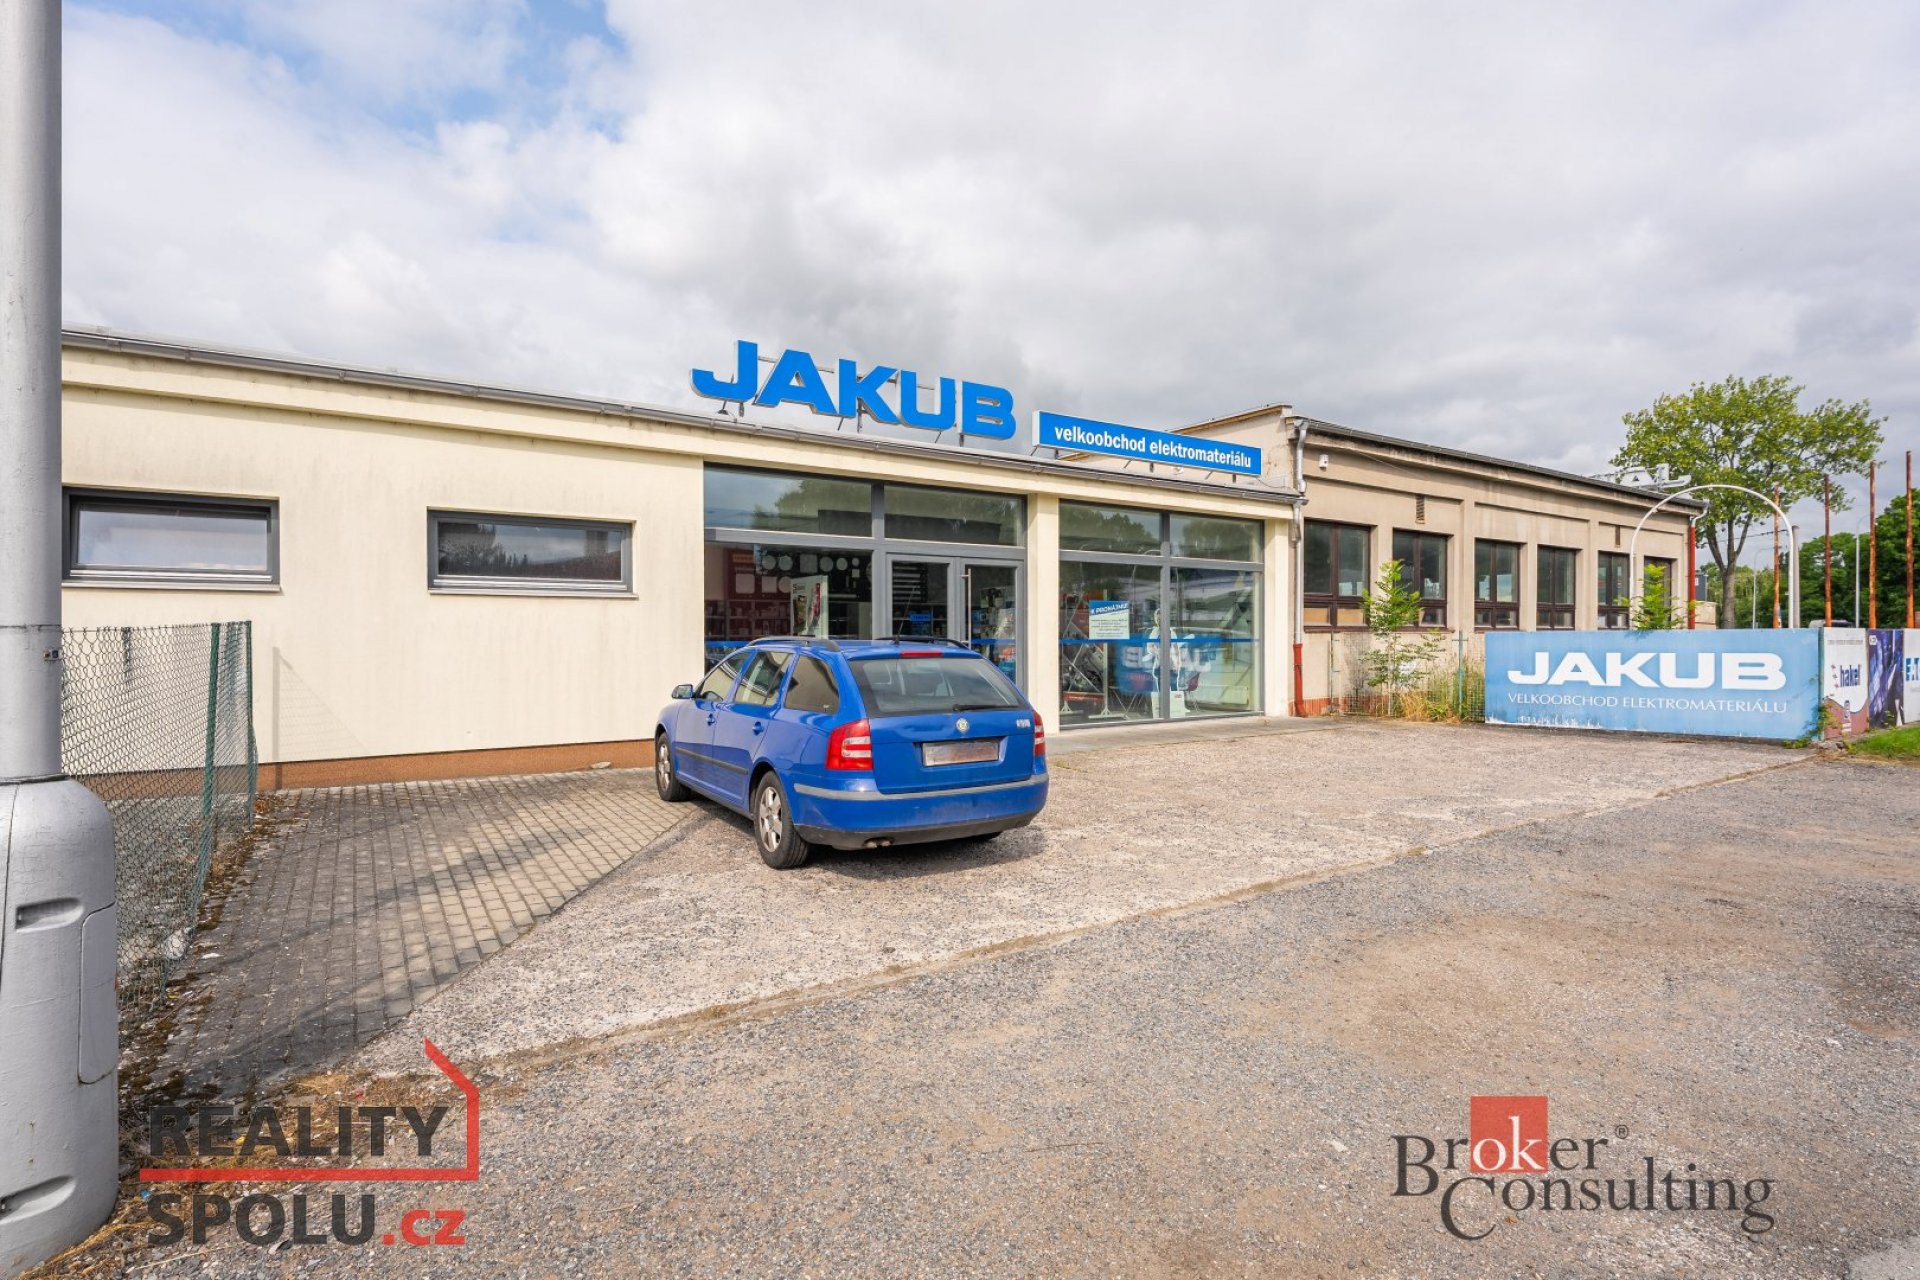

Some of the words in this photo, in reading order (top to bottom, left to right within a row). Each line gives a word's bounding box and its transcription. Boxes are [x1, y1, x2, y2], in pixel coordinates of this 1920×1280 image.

[691, 340, 1016, 440] JAKUB
[1054, 425, 1146, 453] velkoobchod
[1149, 439, 1252, 469] elektromateriálu
[1508, 652, 1787, 690] JAKUB
[1508, 693, 1618, 708] VELKOOBCHOD
[1623, 697, 1788, 714] ELEKTROMATERIÁLU
